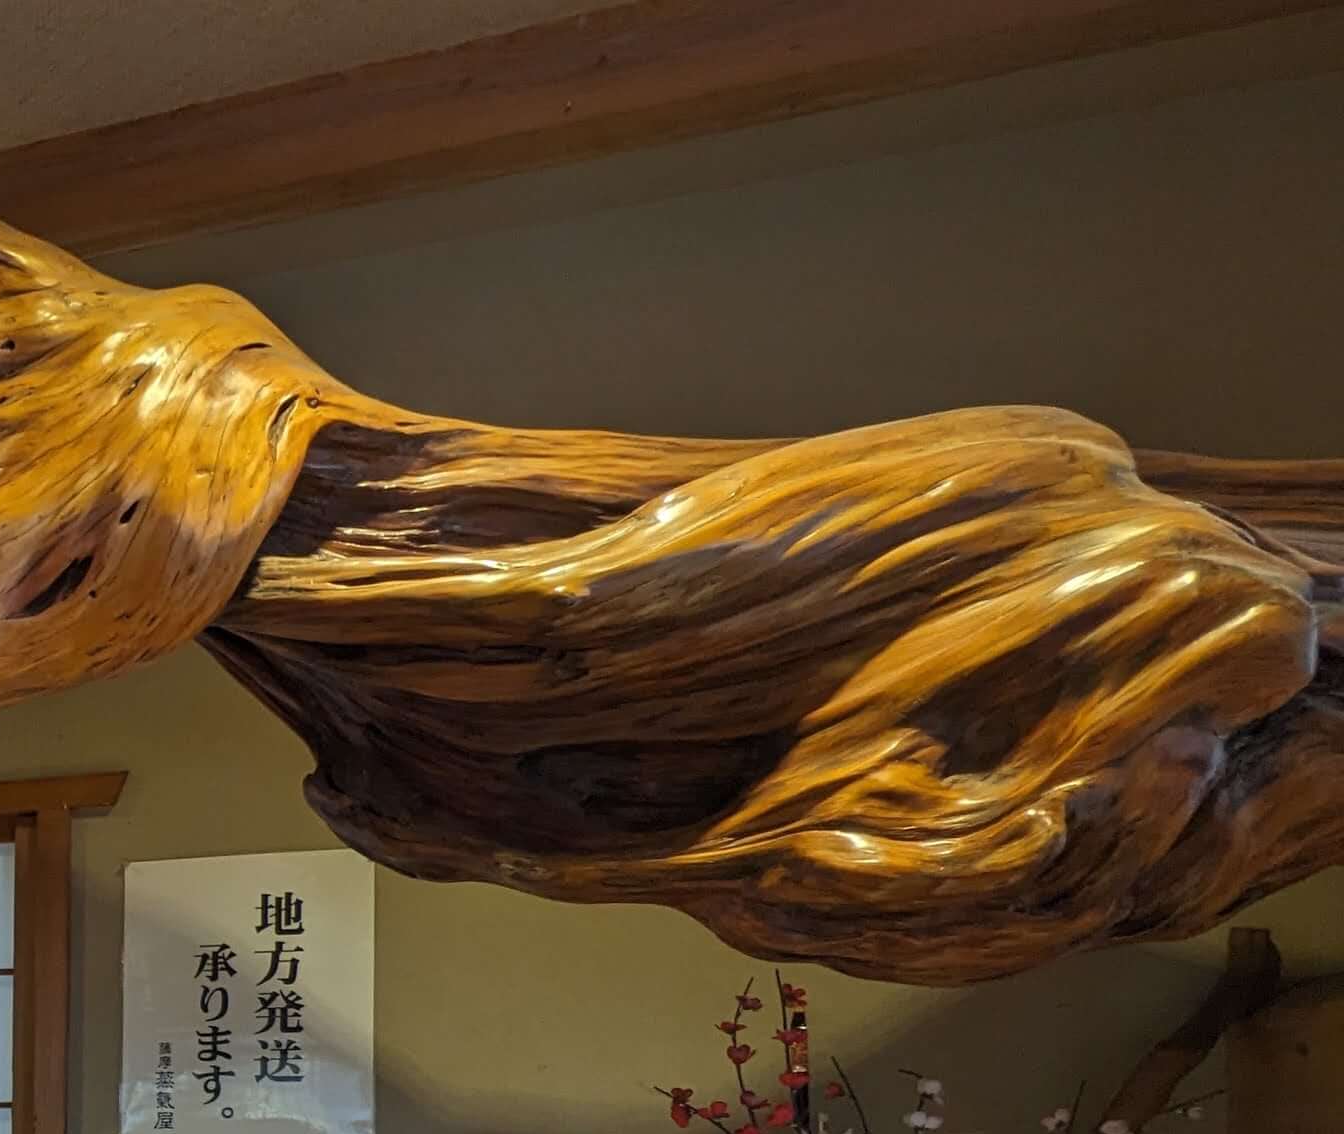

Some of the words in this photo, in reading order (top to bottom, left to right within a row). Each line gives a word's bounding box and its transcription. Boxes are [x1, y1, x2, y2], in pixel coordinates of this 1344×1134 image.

[192, 943, 237, 1119] 承ります。
[255, 892, 305, 1084] 地方発送
